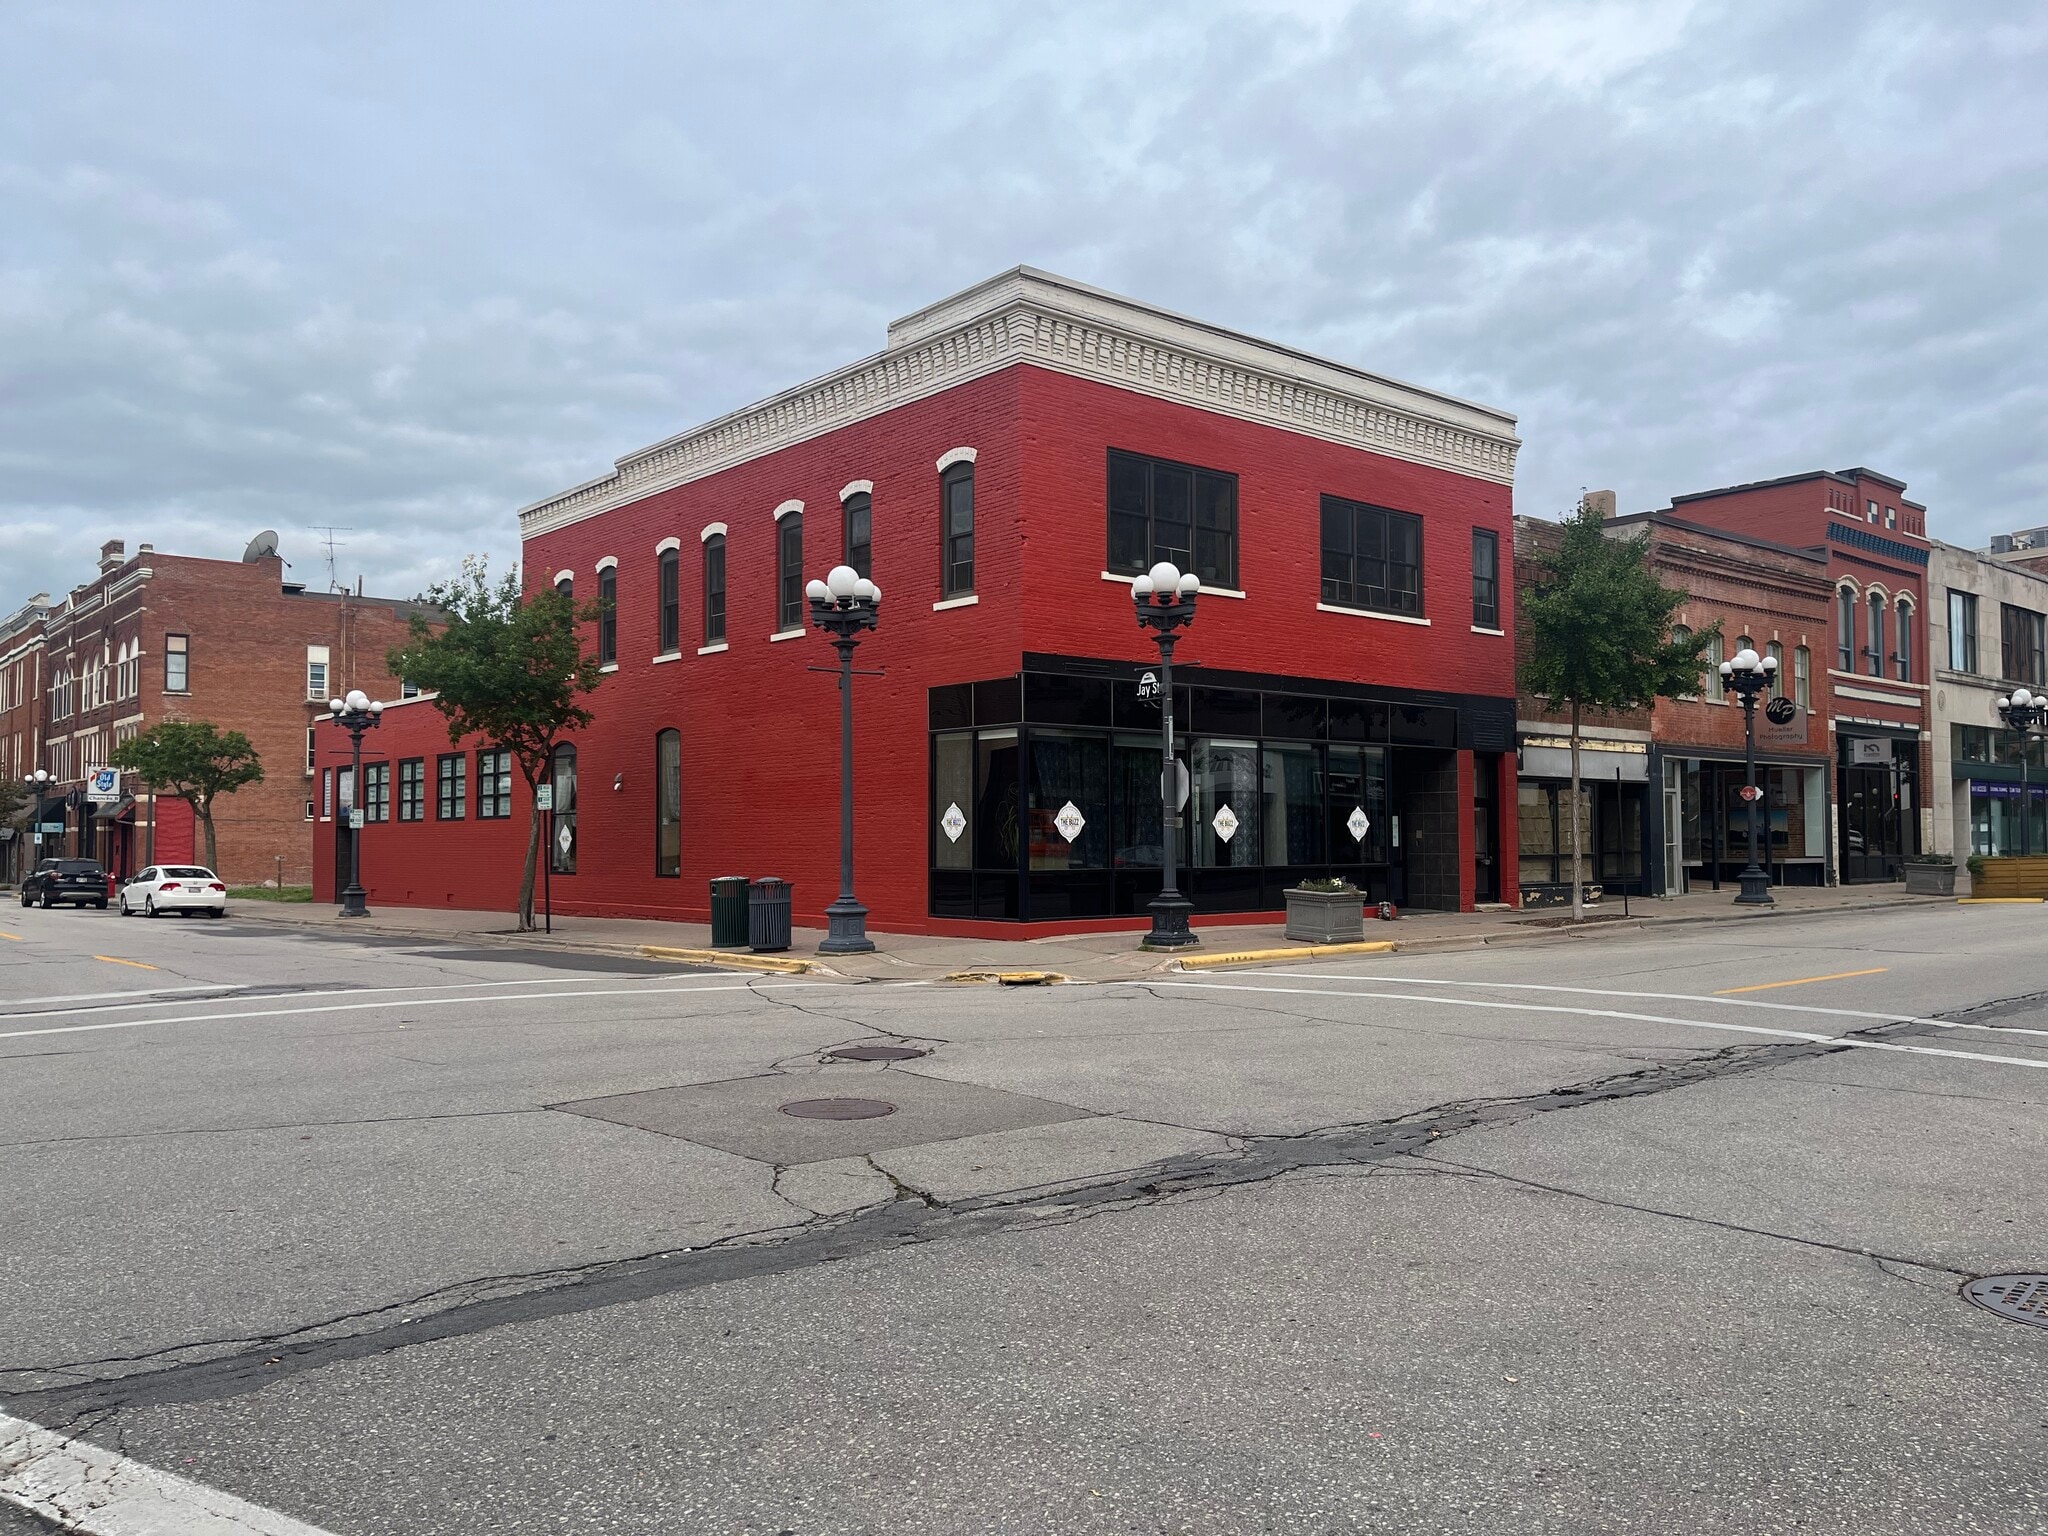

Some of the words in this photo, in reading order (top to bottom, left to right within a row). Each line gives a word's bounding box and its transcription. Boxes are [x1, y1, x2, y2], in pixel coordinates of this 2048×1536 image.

[1136, 684, 1150, 698] Jay
[1152, 682, 1160, 694] St
[100, 773, 111, 781] Old
[96, 780, 112, 790] Style
